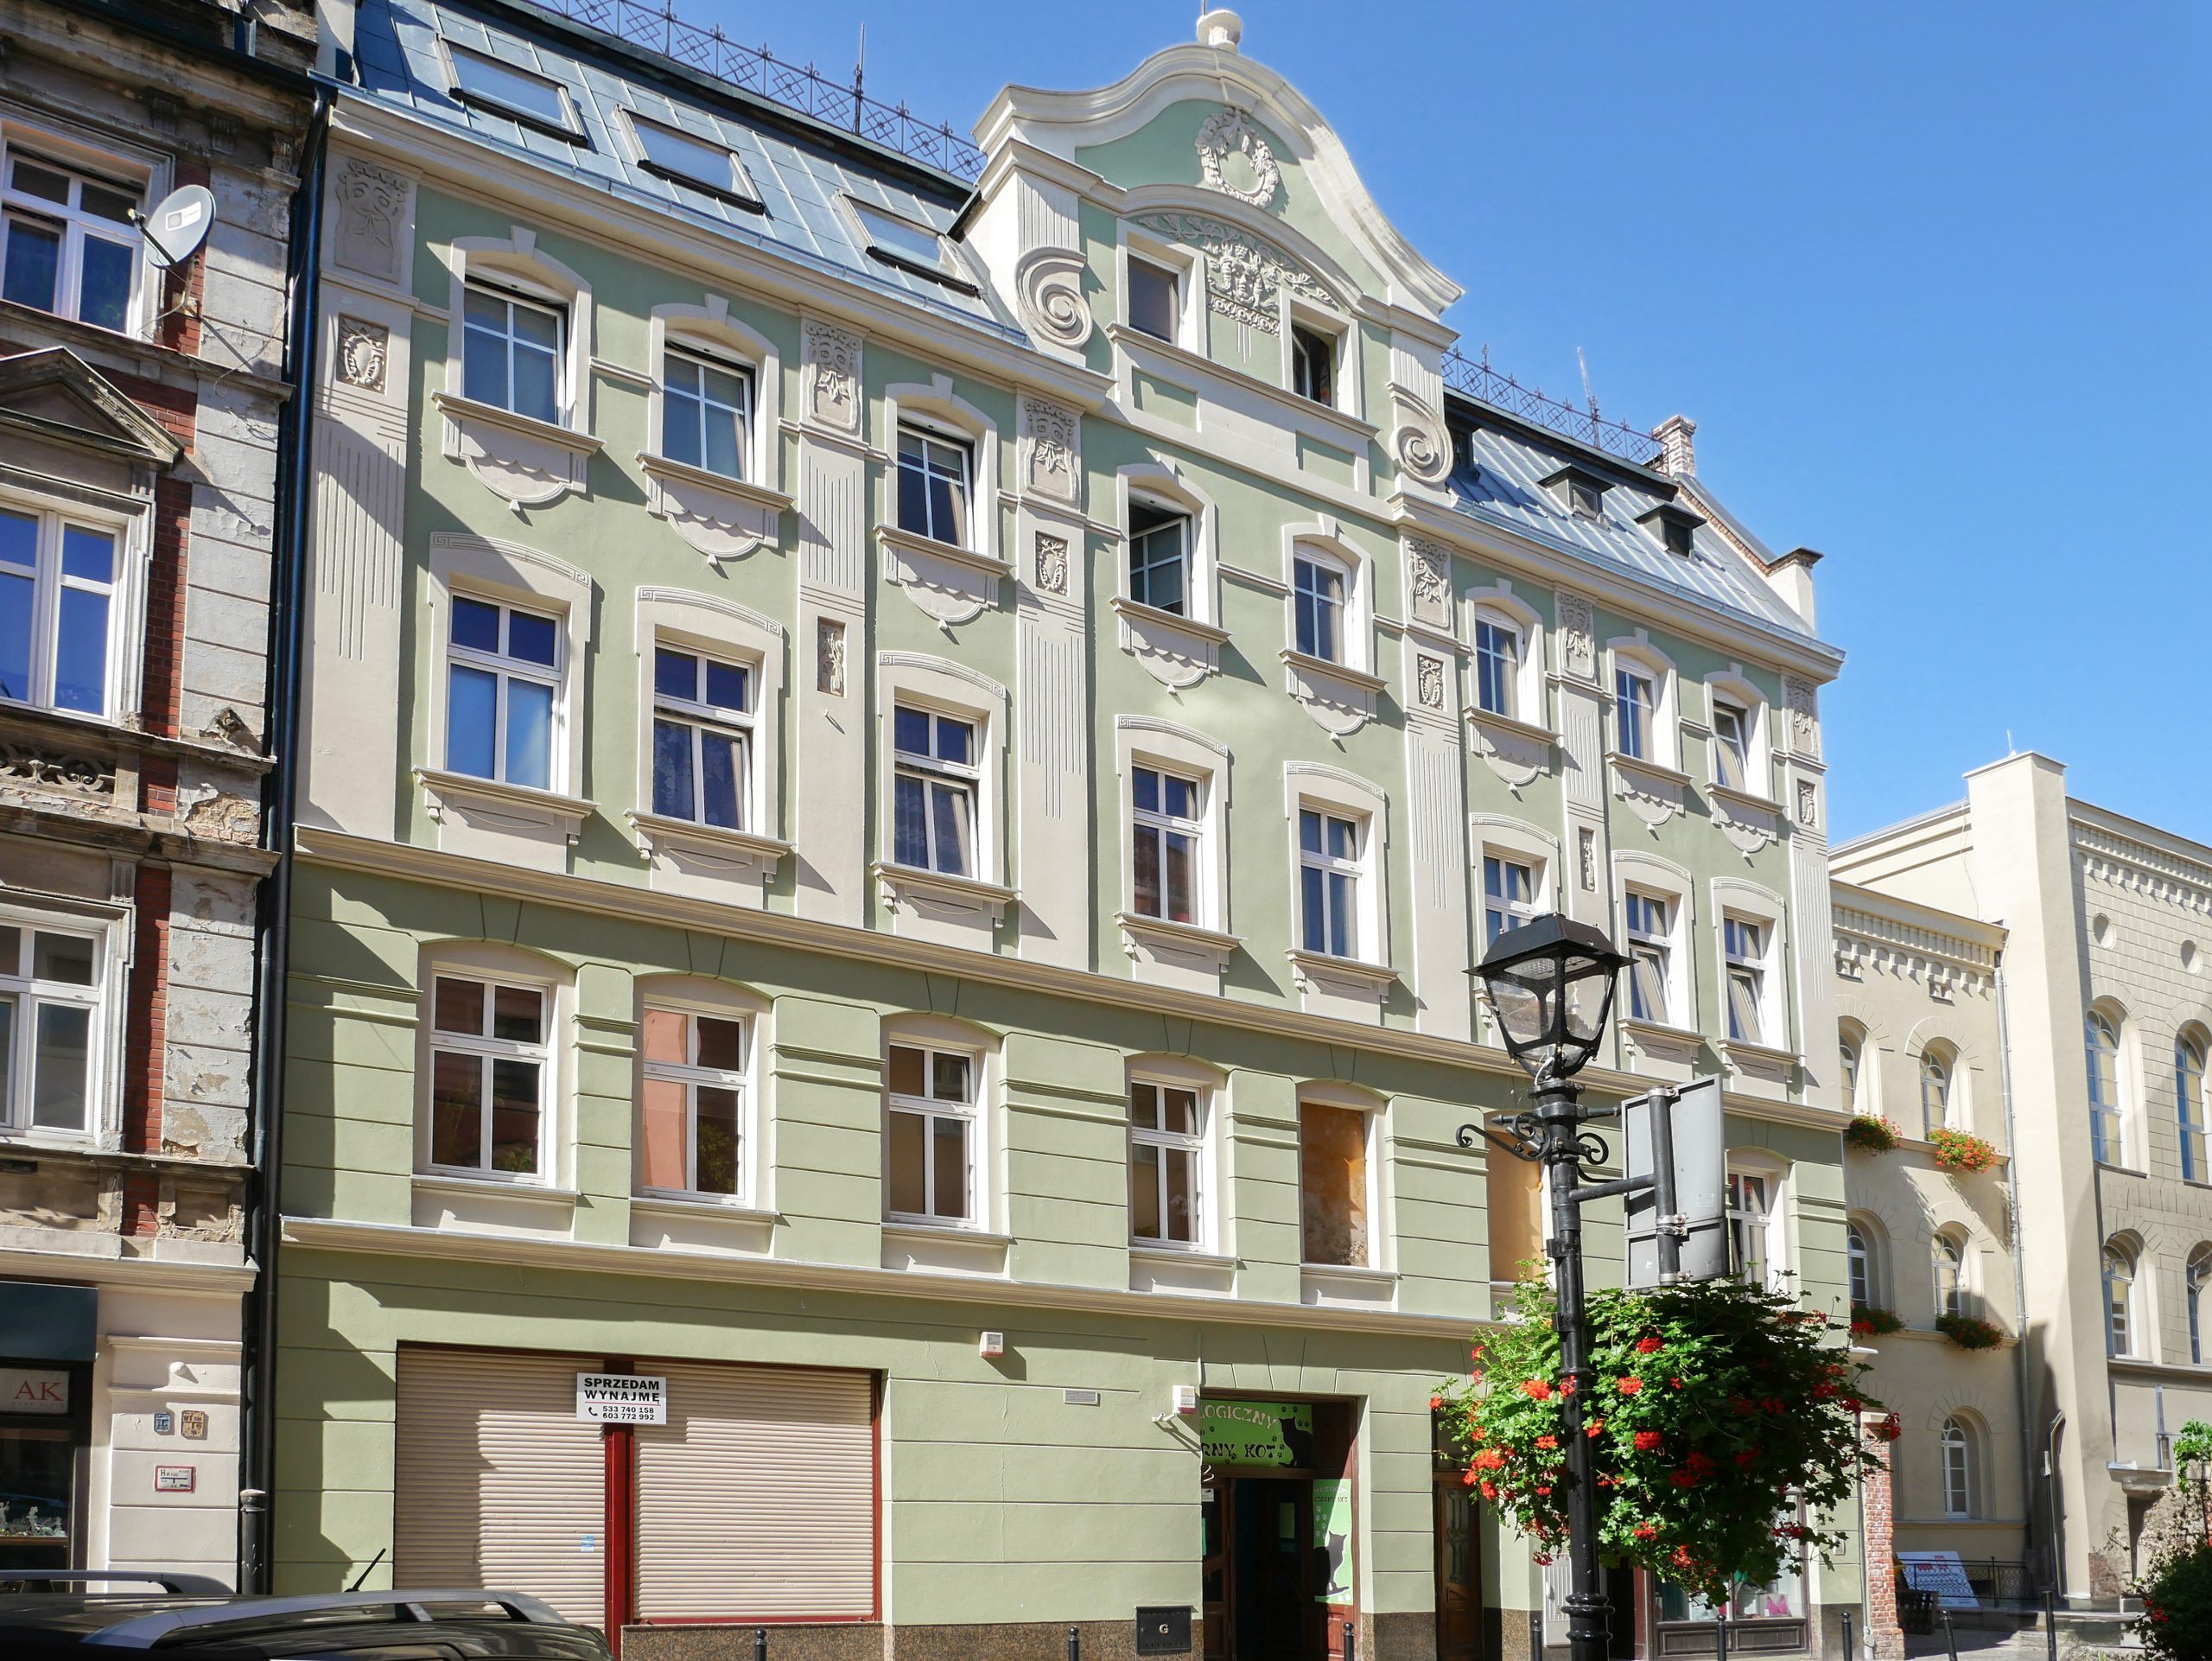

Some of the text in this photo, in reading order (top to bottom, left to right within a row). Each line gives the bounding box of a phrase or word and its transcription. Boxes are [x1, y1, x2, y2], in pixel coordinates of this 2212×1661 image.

[13, 1380, 65, 1402] AK
[584, 1378, 659, 1391] SPRZEDAM
[584, 1390, 660, 1404] WYNAJMĘ
[1244, 1443, 1275, 1458] KOT
[1159, 1624, 1169, 1634] G
